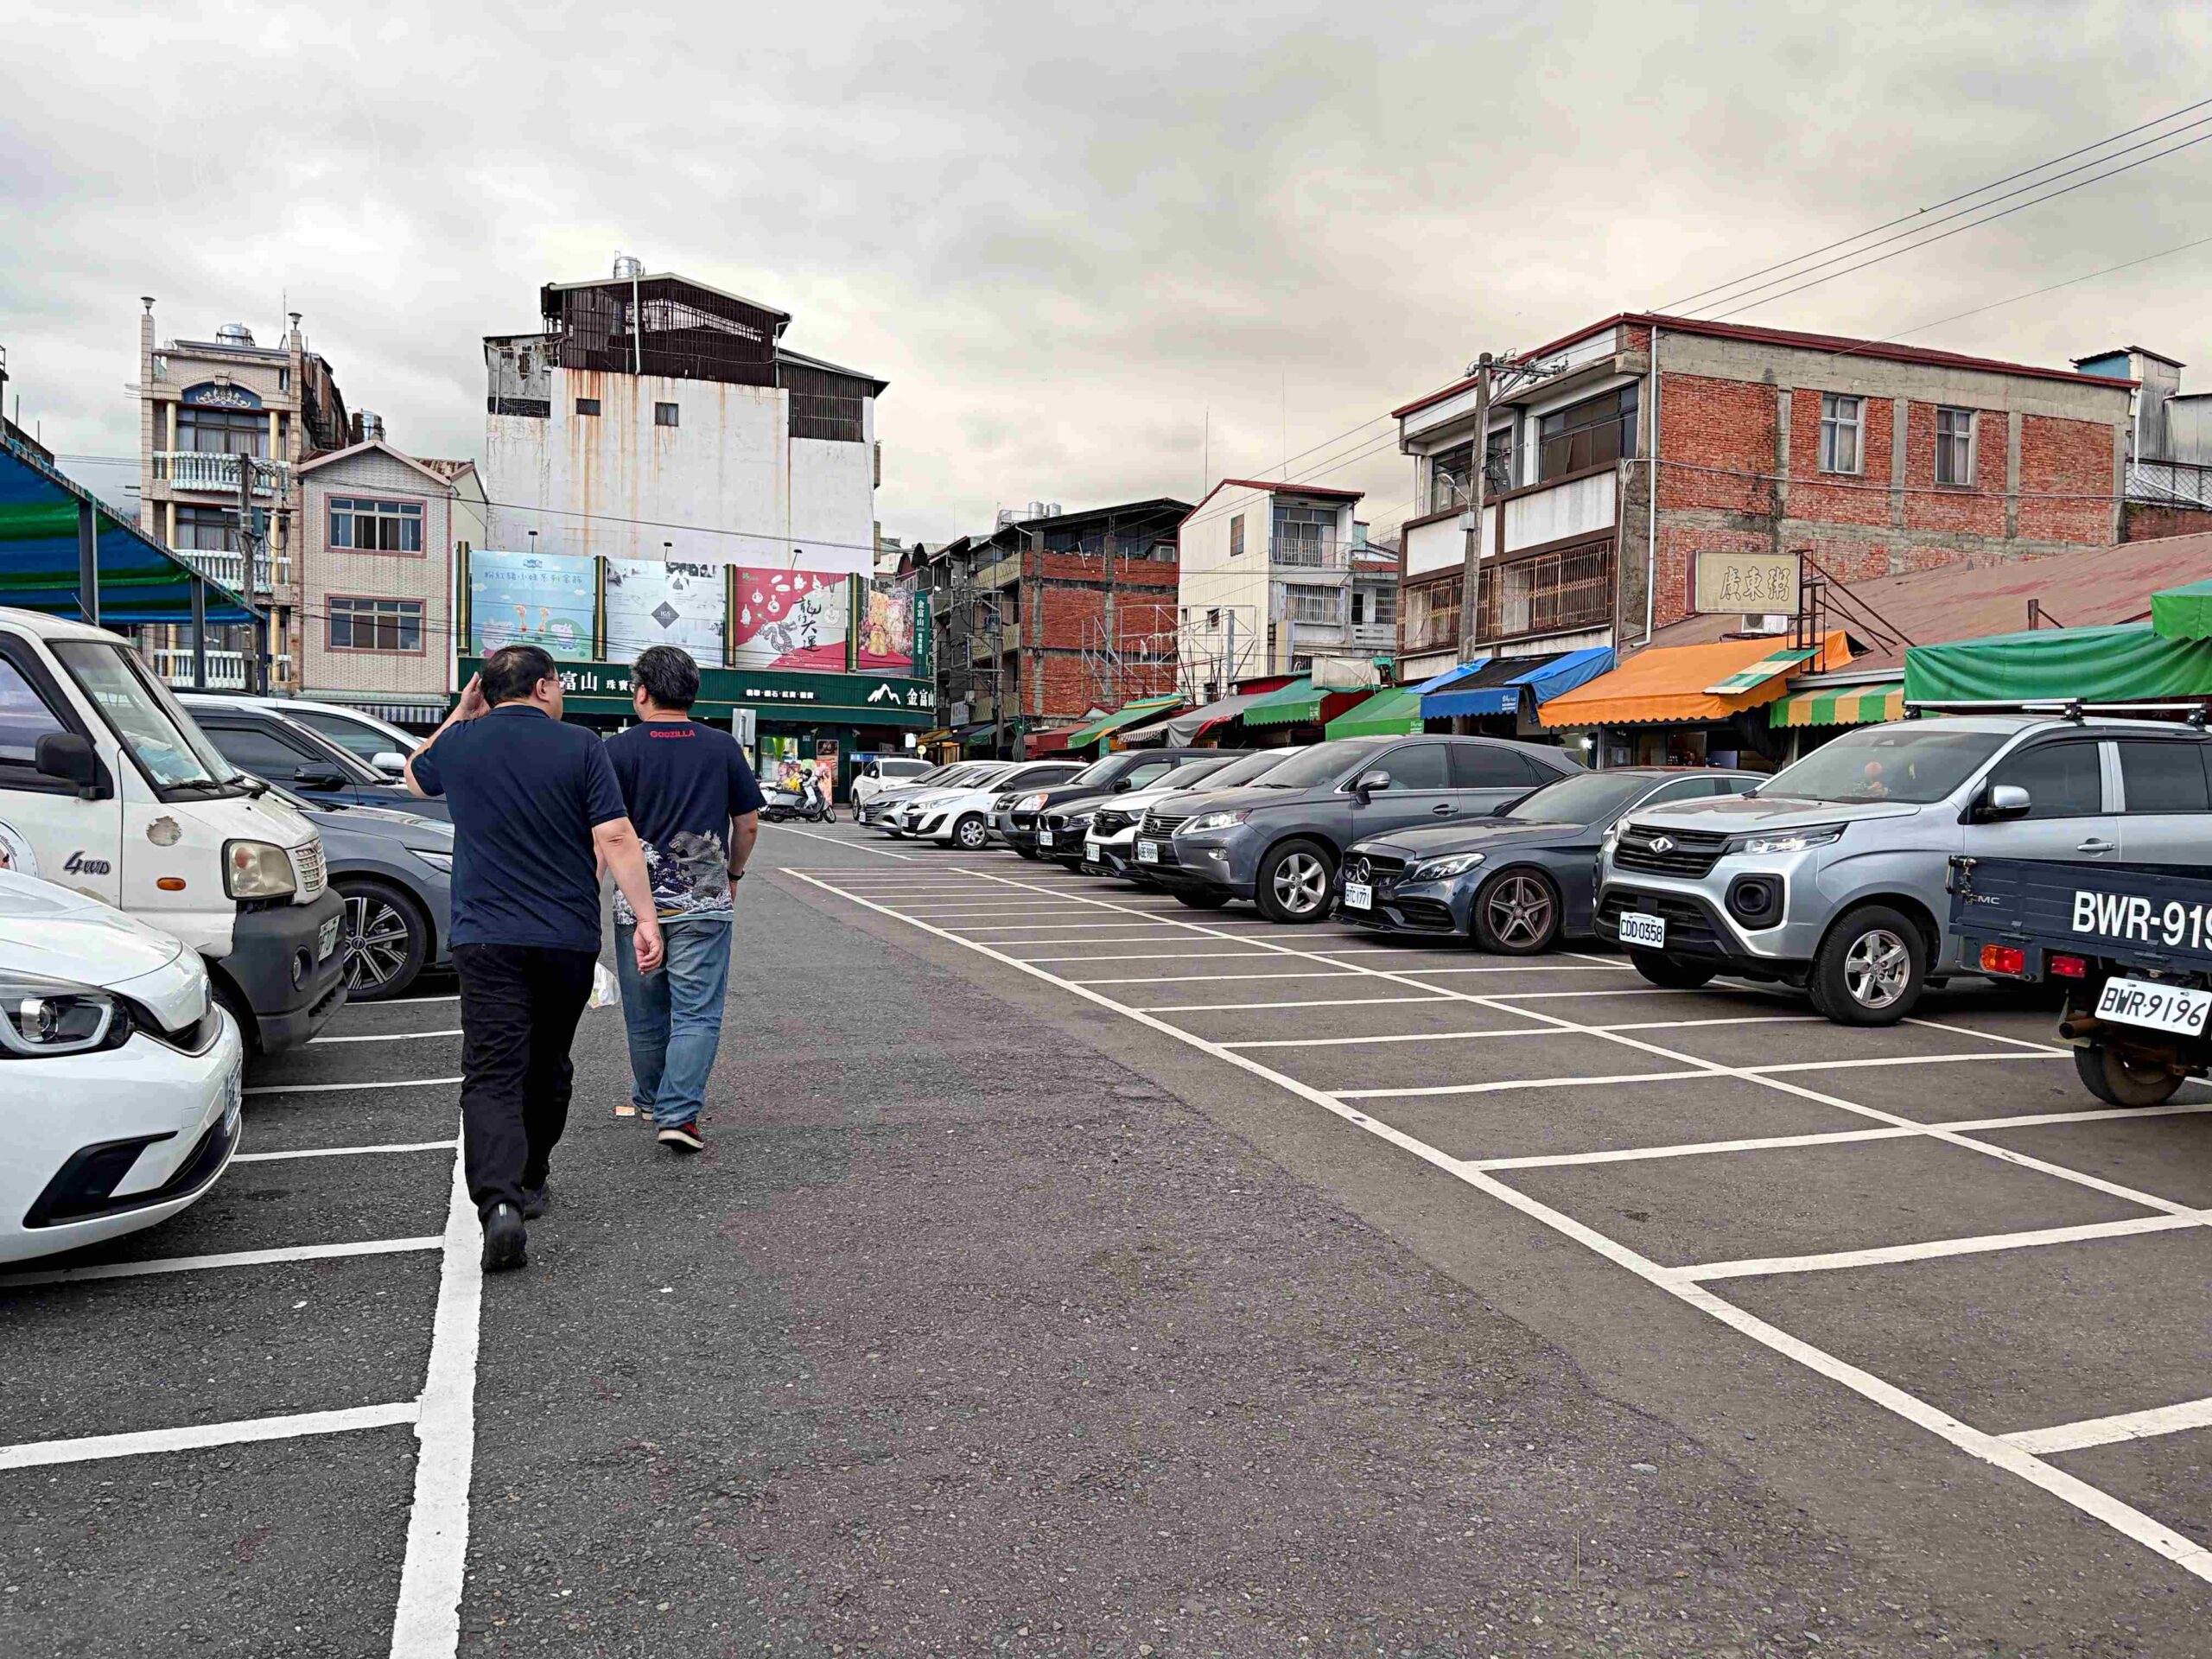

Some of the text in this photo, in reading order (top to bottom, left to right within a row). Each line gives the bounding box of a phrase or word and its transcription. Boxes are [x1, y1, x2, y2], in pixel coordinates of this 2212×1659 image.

[1719, 565, 1791, 601] 廣東粥
[906, 687, 934, 708] 金富山
[650, 729, 696, 738] GODZILLA
[63, 850, 111, 875] 4WD
[1620, 918, 1662, 943] CDD-0358
[2100, 987, 2207, 1027] BWR-9196
